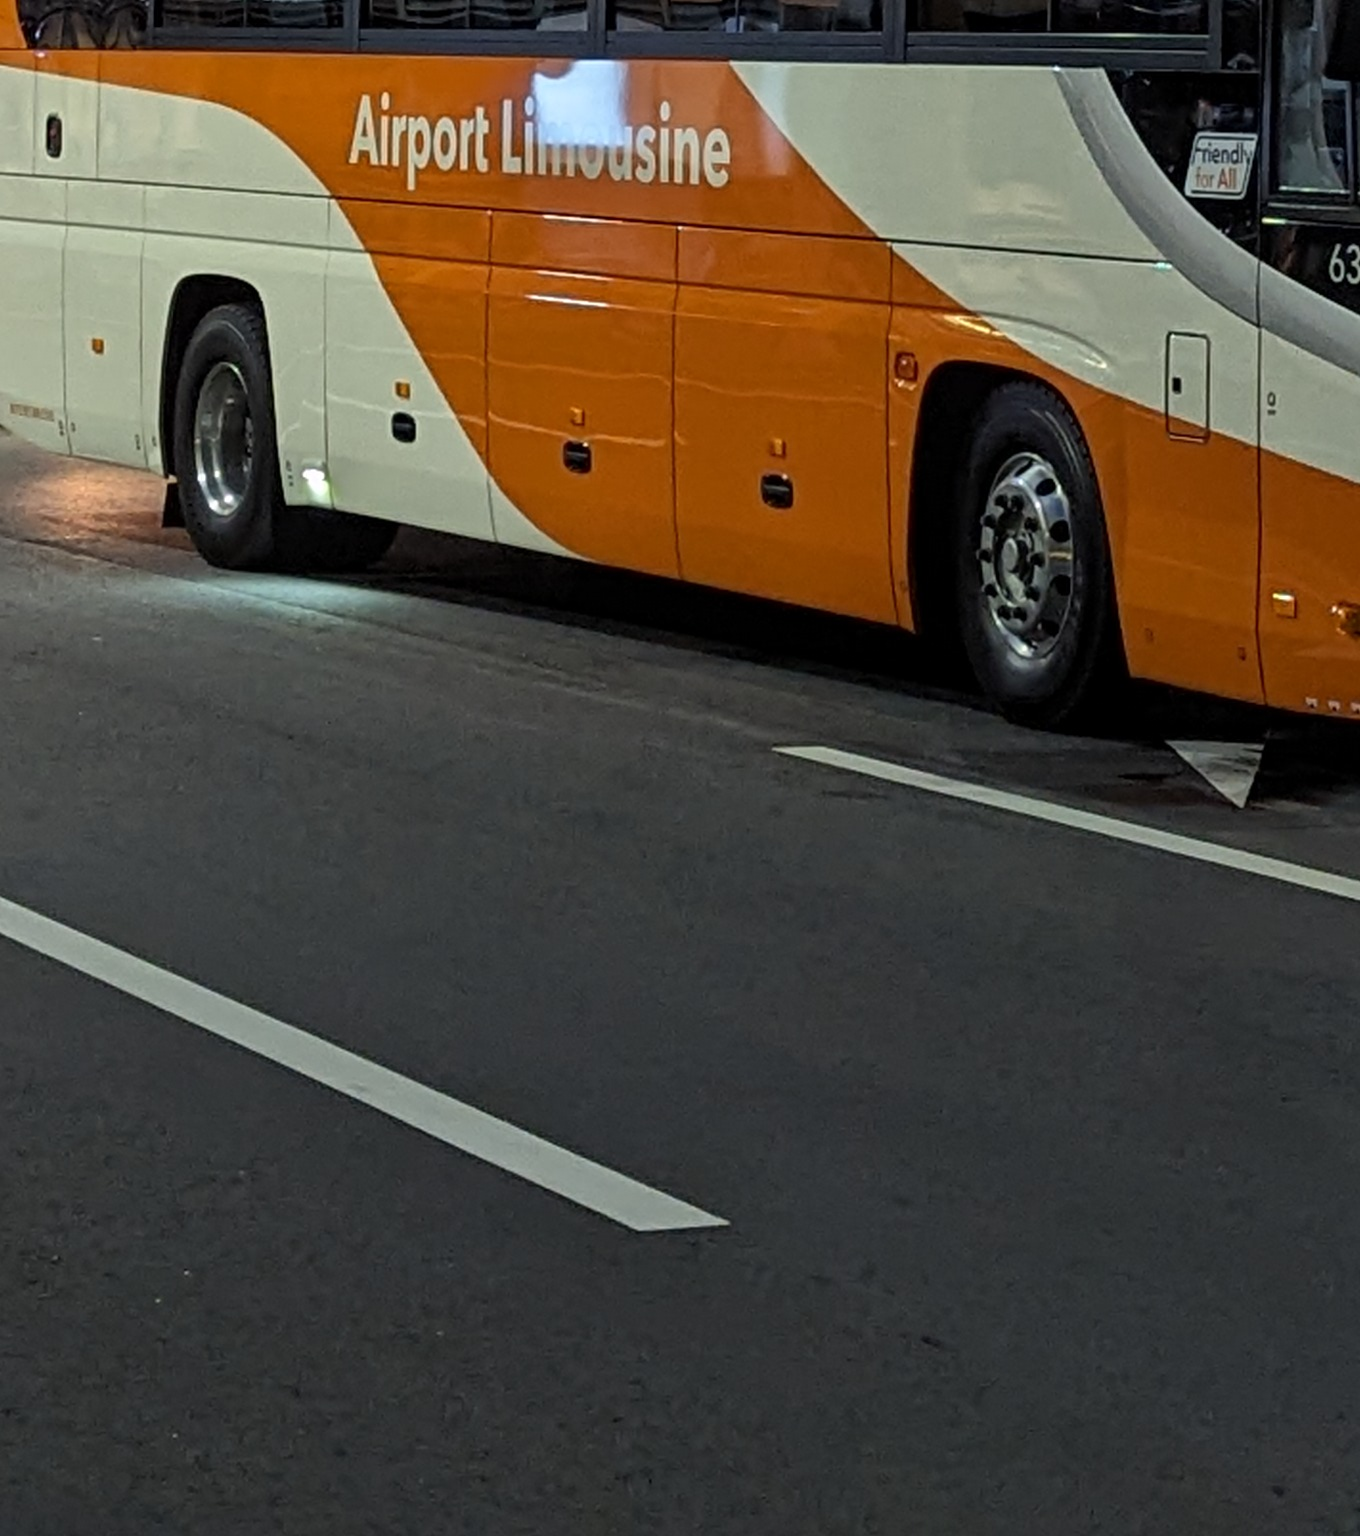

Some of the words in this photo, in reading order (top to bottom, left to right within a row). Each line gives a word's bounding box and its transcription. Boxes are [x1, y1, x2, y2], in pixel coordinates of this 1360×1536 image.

[349, 91, 491, 191] Airport
[501, 95, 732, 188] Limousine
[1191, 142, 1254, 165] Friendly
[1196, 168, 1214, 188] for
[1217, 167, 1237, 190] All
